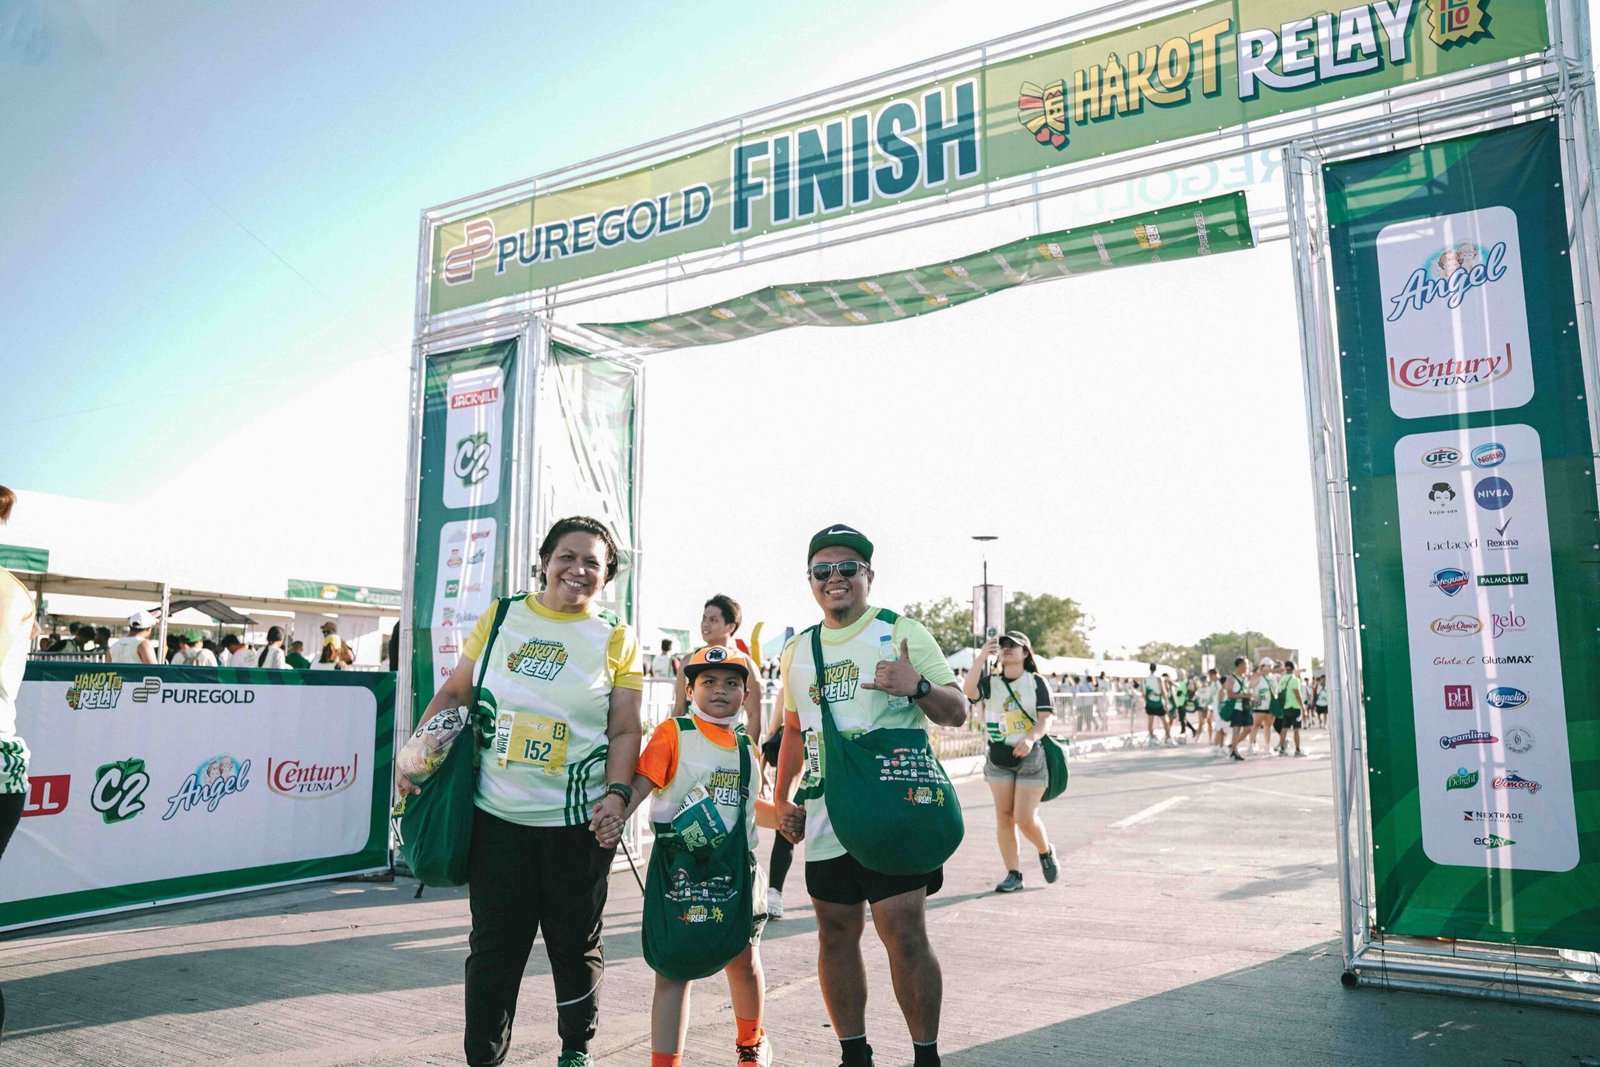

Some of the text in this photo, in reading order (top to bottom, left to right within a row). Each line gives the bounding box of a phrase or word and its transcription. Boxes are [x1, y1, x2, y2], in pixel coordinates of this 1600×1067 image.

[1074, 0, 1413, 122] HAKOT RELAY
[733, 80, 977, 231] FINISH
[497, 185, 712, 273] PUREGOLD
[1387, 242, 1508, 322] Angel
[1399, 355, 1501, 387] Century
[1432, 376, 1480, 387] TUNA
[454, 440, 491, 485] C2
[1426, 452, 1458, 462] UFC
[1478, 489, 1510, 498] NIVEA
[1426, 538, 1479, 552] Lactacyd
[1487, 539, 1519, 548] Rexona
[1480, 575, 1525, 584] PALMOLIVE
[1436, 620, 1479, 632] Lady's Choice
[1491, 611, 1526, 639] Belo
[517, 641, 565, 664] HAKOT
[1482, 655, 1532, 665] GlutaMAX
[515, 656, 564, 681] RELAY
[74, 671, 117, 690] HAKOT
[78, 688, 121, 710] RELAY
[161, 689, 255, 704] PUREGOLD
[1447, 688, 1469, 707] pH
[1487, 691, 1526, 706] Magnolia
[555, 724, 565, 737] B
[1440, 730, 1491, 750] Creamline
[496, 731, 509, 754] WAVE
[524, 739, 552, 762] 152
[809, 751, 820, 774] WAVE
[273, 759, 350, 792] Century
[709, 771, 741, 790] HAKOT
[1491, 776, 1541, 795] Cimory
[23, 781, 60, 811] LL
[91, 767, 150, 819] C2
[162, 759, 251, 821] Angel
[298, 782, 332, 793] TUNA
[713, 786, 739, 808] RELA
[1476, 811, 1524, 819] NEXTRADE
[680, 820, 708, 852] 152
